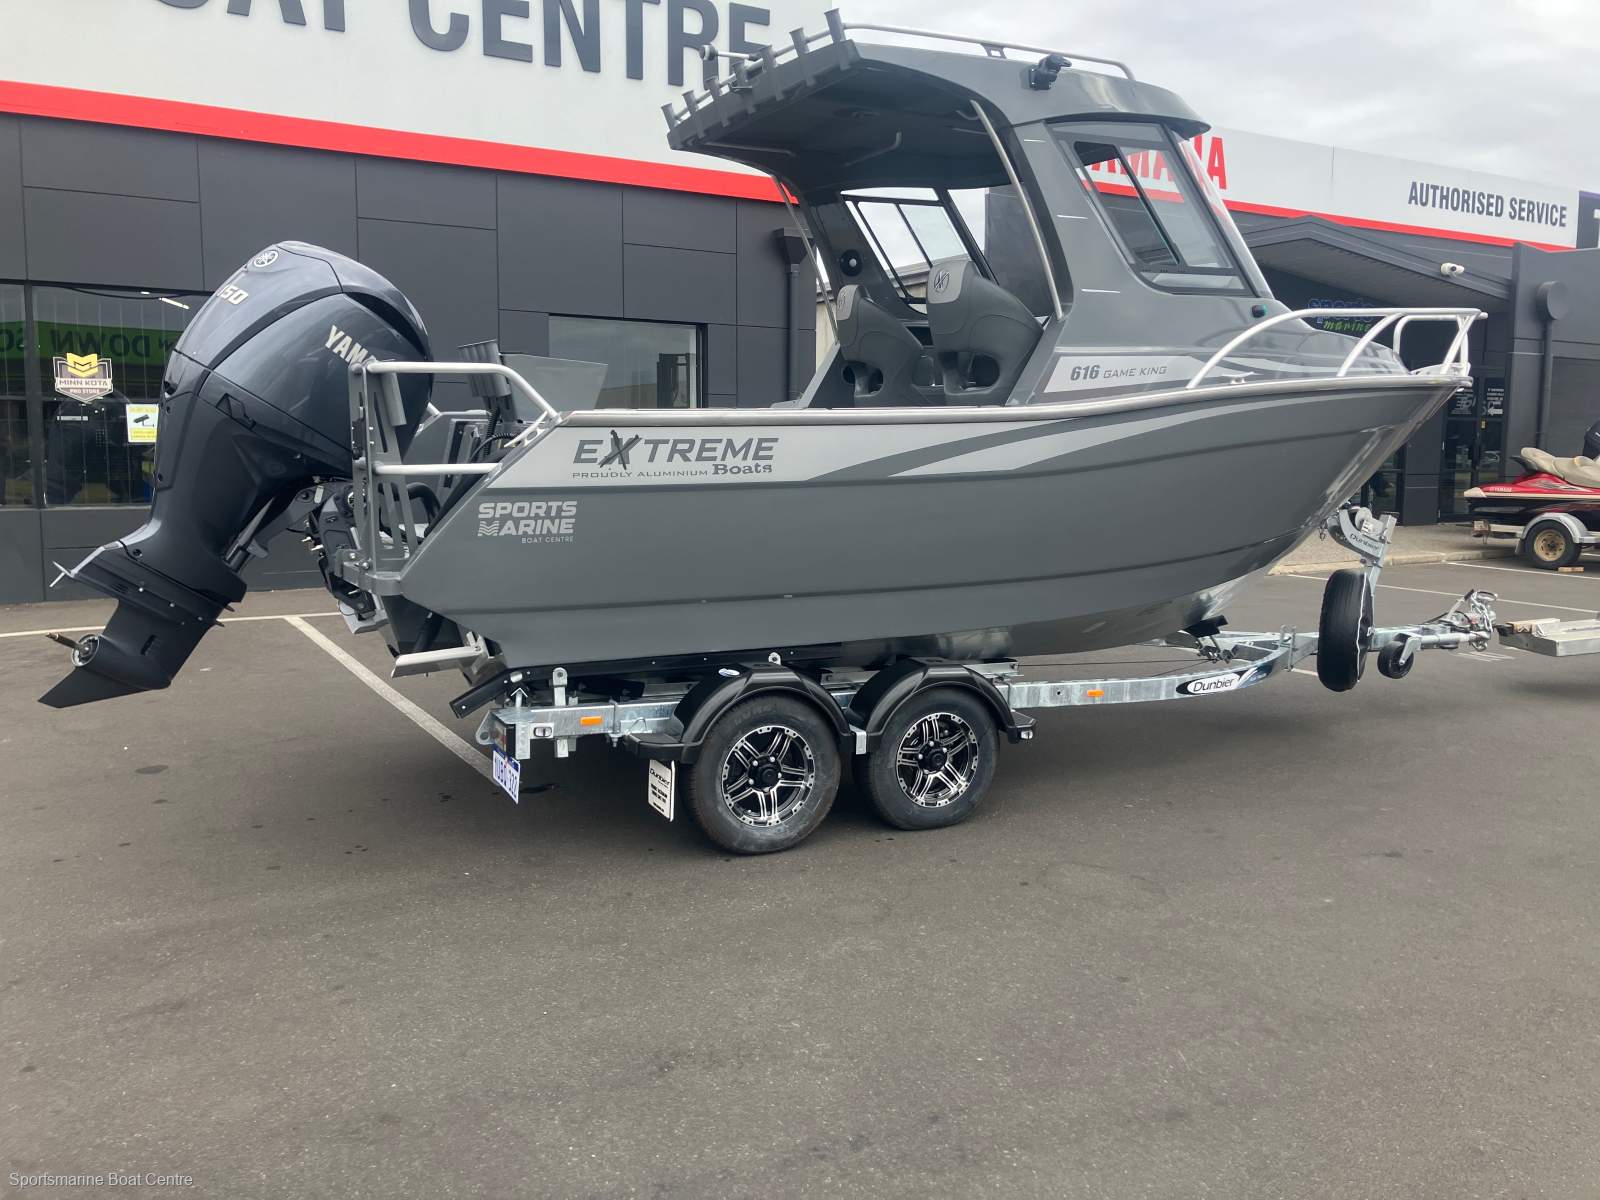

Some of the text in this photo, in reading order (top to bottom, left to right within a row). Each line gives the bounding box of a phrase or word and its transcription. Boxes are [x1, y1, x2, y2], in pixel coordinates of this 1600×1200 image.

[409, 0, 770, 89] CENTRE
[1408, 181, 1568, 228] AUTHORISED SERVICE
[325, 324, 377, 366] YAM
[1070, 365, 1167, 381] 616 GAME KING
[59, 379, 83, 387] MINN
[573, 429, 779, 470] EXTREME
[572, 470, 708, 479] PROUDLY ALUMINIUM
[712, 462, 773, 476] Boats
[478, 500, 578, 519] SPORTS
[545, 535, 575, 543] CENTRE
[1193, 678, 1236, 692] Dunbier
